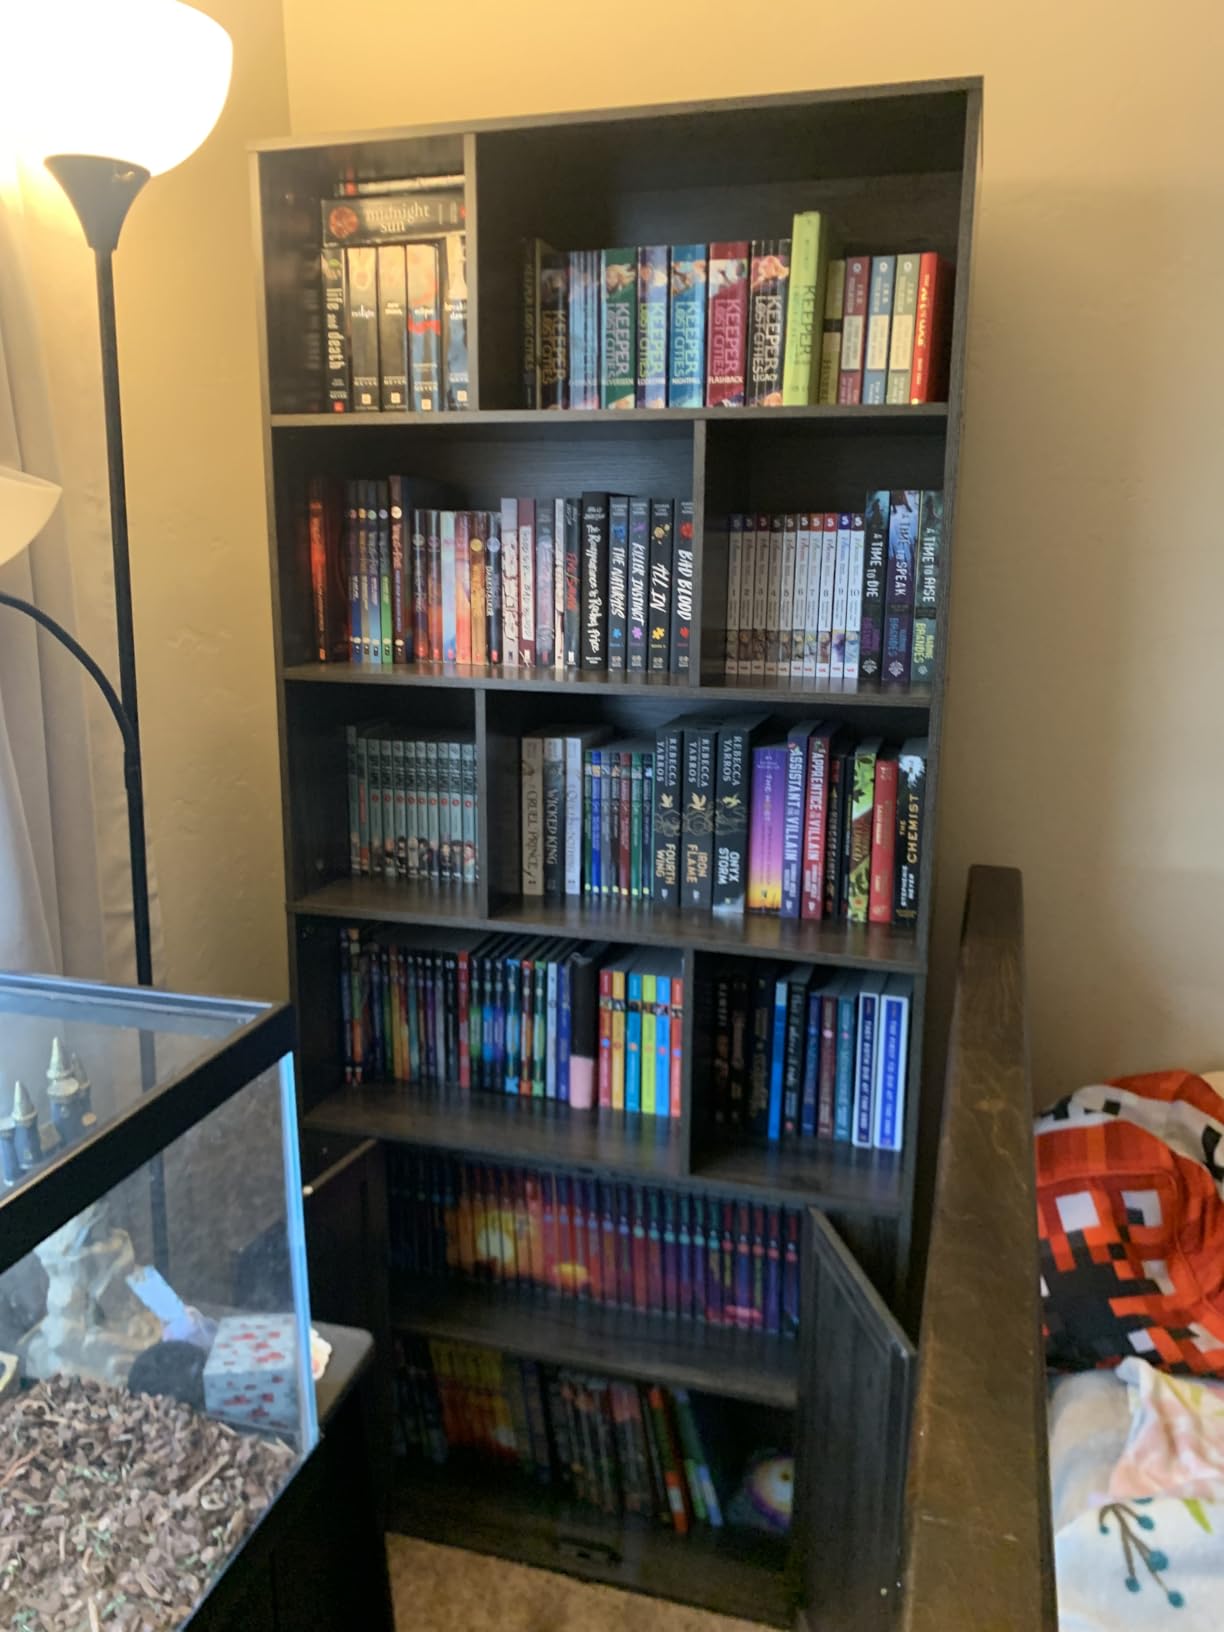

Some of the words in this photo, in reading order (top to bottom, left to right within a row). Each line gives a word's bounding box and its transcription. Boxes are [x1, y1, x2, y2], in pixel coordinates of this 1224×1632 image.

[365, 202, 431, 223] midnight
[380, 221, 406, 233] sun
[326, 288, 343, 310] life
[801, 284, 816, 354] KEEPER
[328, 331, 345, 369] death
[616, 302, 630, 375] KEEPER
[649, 302, 664, 375] KEEPER
[685, 301, 700, 375] KEEPER
[725, 299, 740, 375] KEEPER
[766, 295, 782, 369] KEEPER
[708, 376, 744, 384] FLASHBACK
[870, 541, 883, 566] TIME
[899, 521, 911, 546] TIME
[922, 537, 936, 564] TIME
[613, 547, 626, 567] THE
[632, 542, 646, 577] KILLER
[652, 562, 671, 588] ALL
[678, 549, 694, 577] BAD
[610, 567, 626, 619] NATURALS
[866, 580, 880, 598] DIE
[895, 560, 908, 597] SPEAK
[632, 579, 645, 627] INSTINCT
[650, 588, 667, 613] IN
[677, 579, 693, 621] BLOOD
[656, 741, 665, 783] YARROS
[669, 738, 678, 787] REBECCA
[689, 742, 697, 783] YARROS
[701, 738, 710, 788] REBECCA
[722, 739, 732, 783] YARROS
[732, 735, 743, 787] REBECCA
[788, 750, 803, 808] ASSISTANT
[809, 751, 825, 811] APPRENTICE
[528, 790, 538, 825] CRUEL
[546, 788, 559, 830] WICKED
[899, 820, 907, 835] THE
[546, 830, 558, 865] KING
[783, 817, 800, 862] VILLAIN
[807, 819, 821, 862] VILLAIN
[906, 793, 919, 864] CHEMIST
[527, 829, 538, 870] PRINCE
[655, 849, 665, 878] WING
[665, 843, 676, 885] FOURTH
[687, 843, 698, 884] FLAME
[698, 851, 708, 878] IRON
[718, 847, 730, 885] STORM
[729, 851, 740, 883] ONYX
